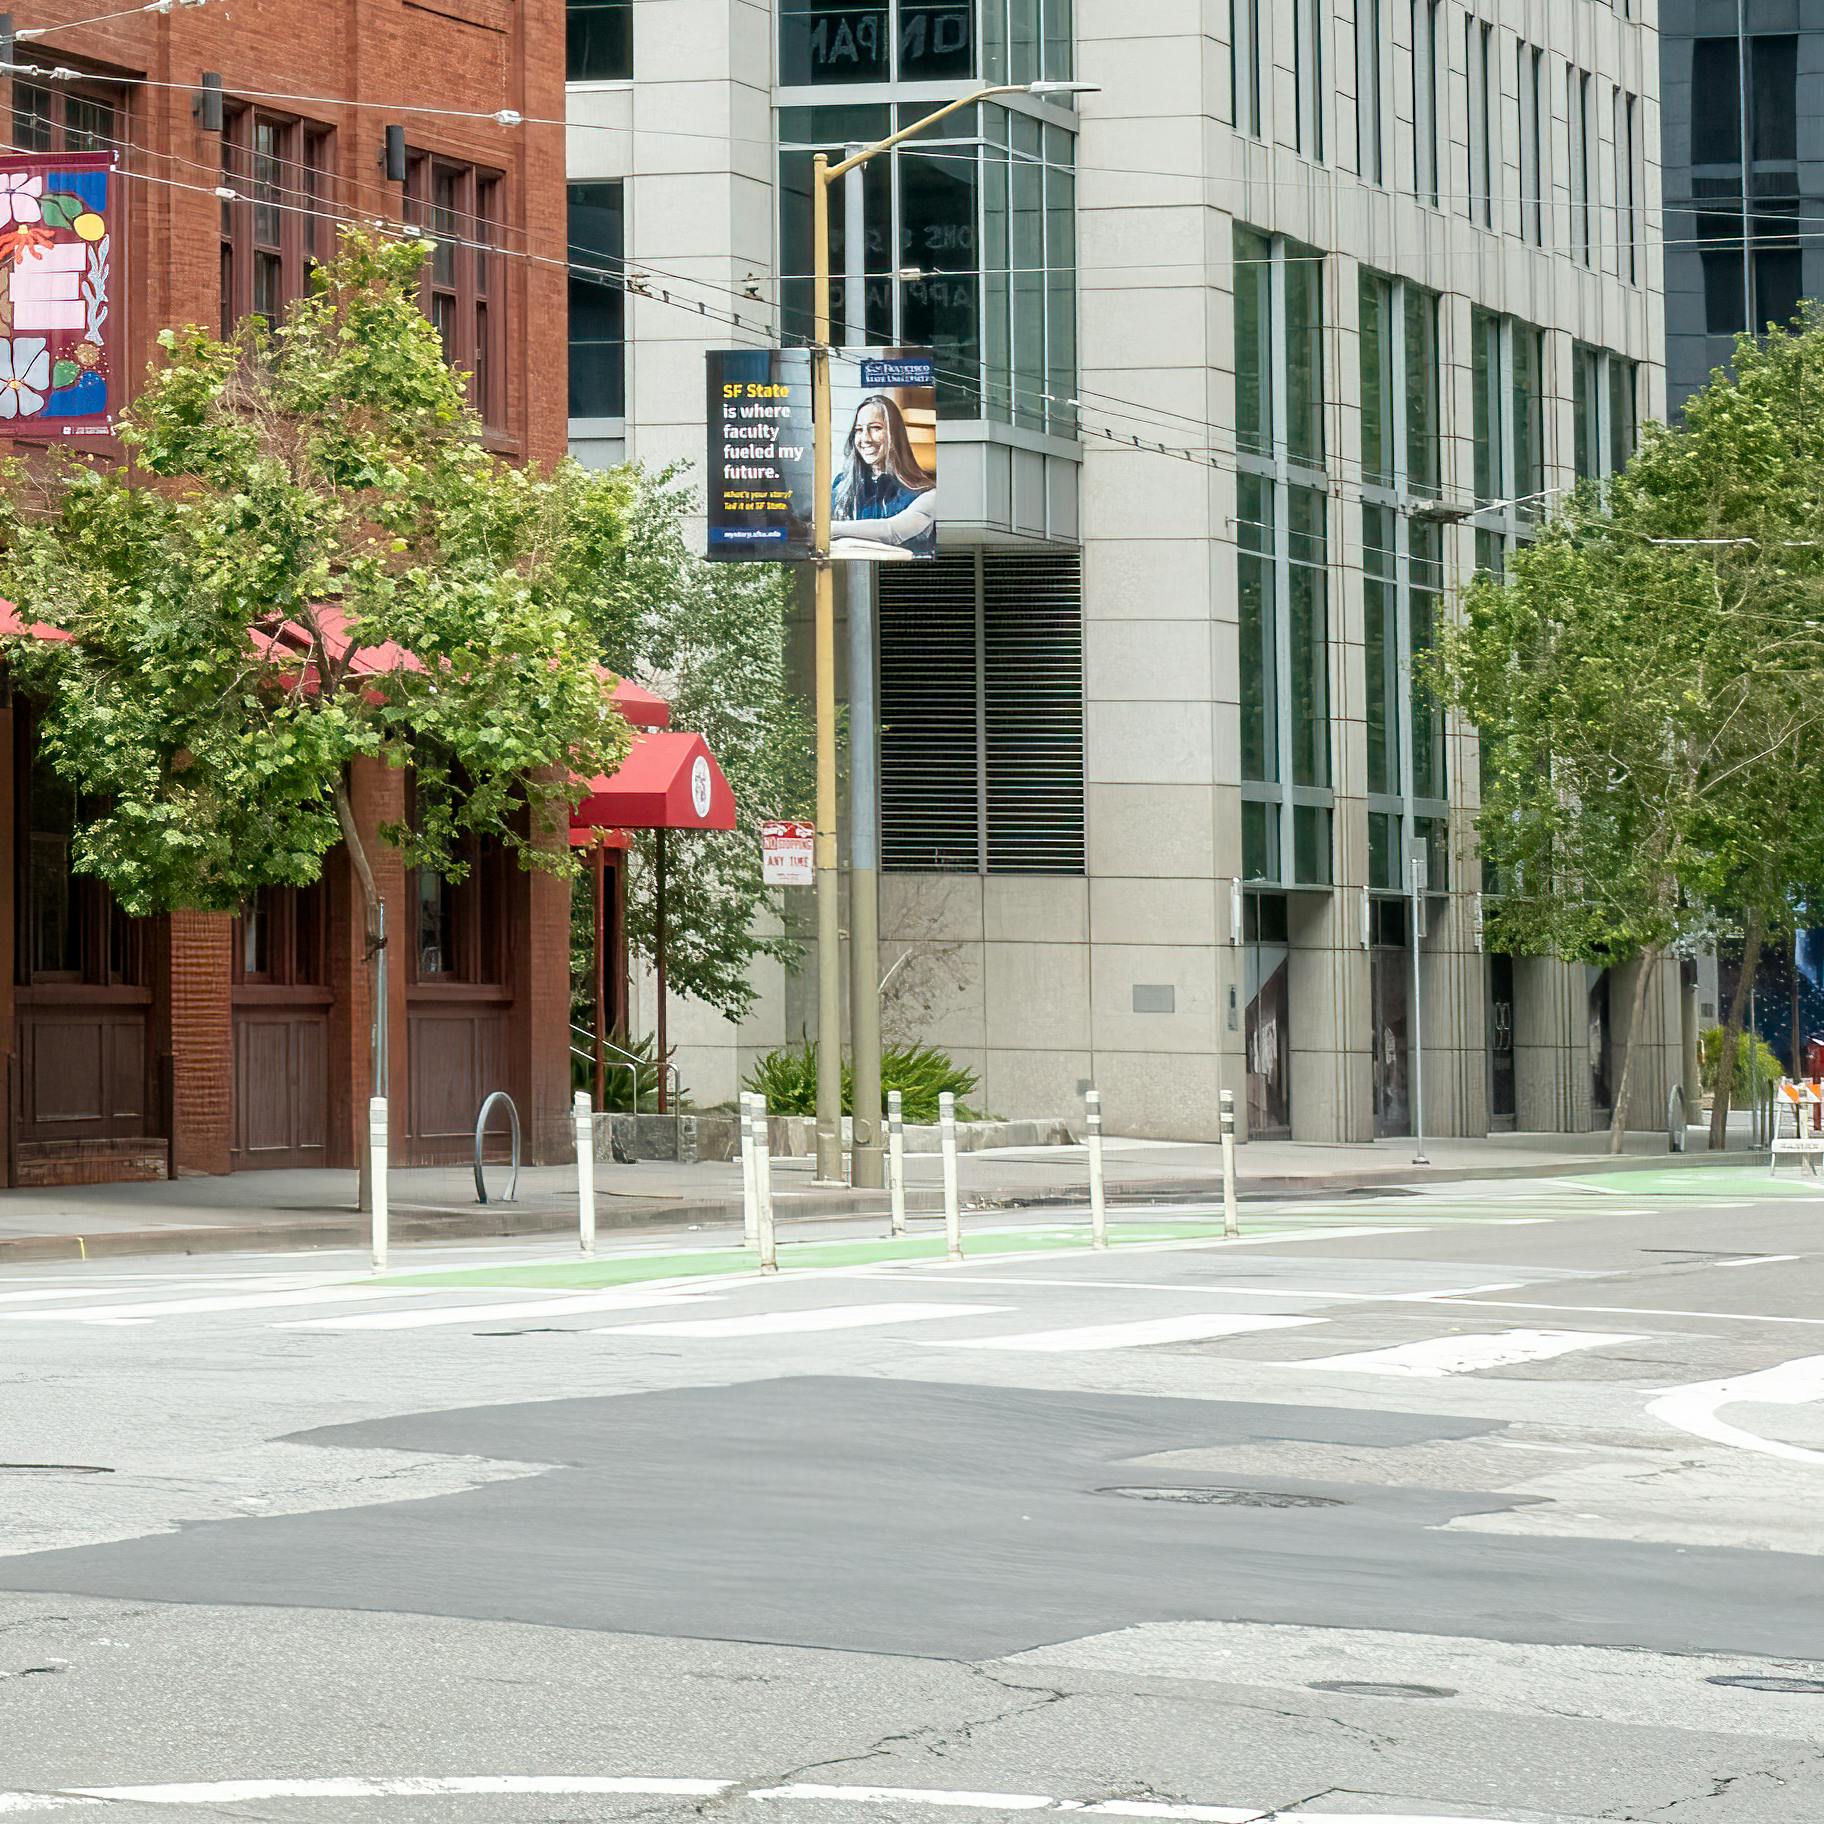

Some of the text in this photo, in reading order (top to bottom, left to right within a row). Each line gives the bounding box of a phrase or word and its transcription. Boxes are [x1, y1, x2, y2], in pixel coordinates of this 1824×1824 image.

[723, 384, 790, 398] SF State
[723, 404, 791, 418] is where
[723, 423, 780, 441] faculty
[723, 443, 804, 462] fueled my
[723, 464, 780, 479] future.
